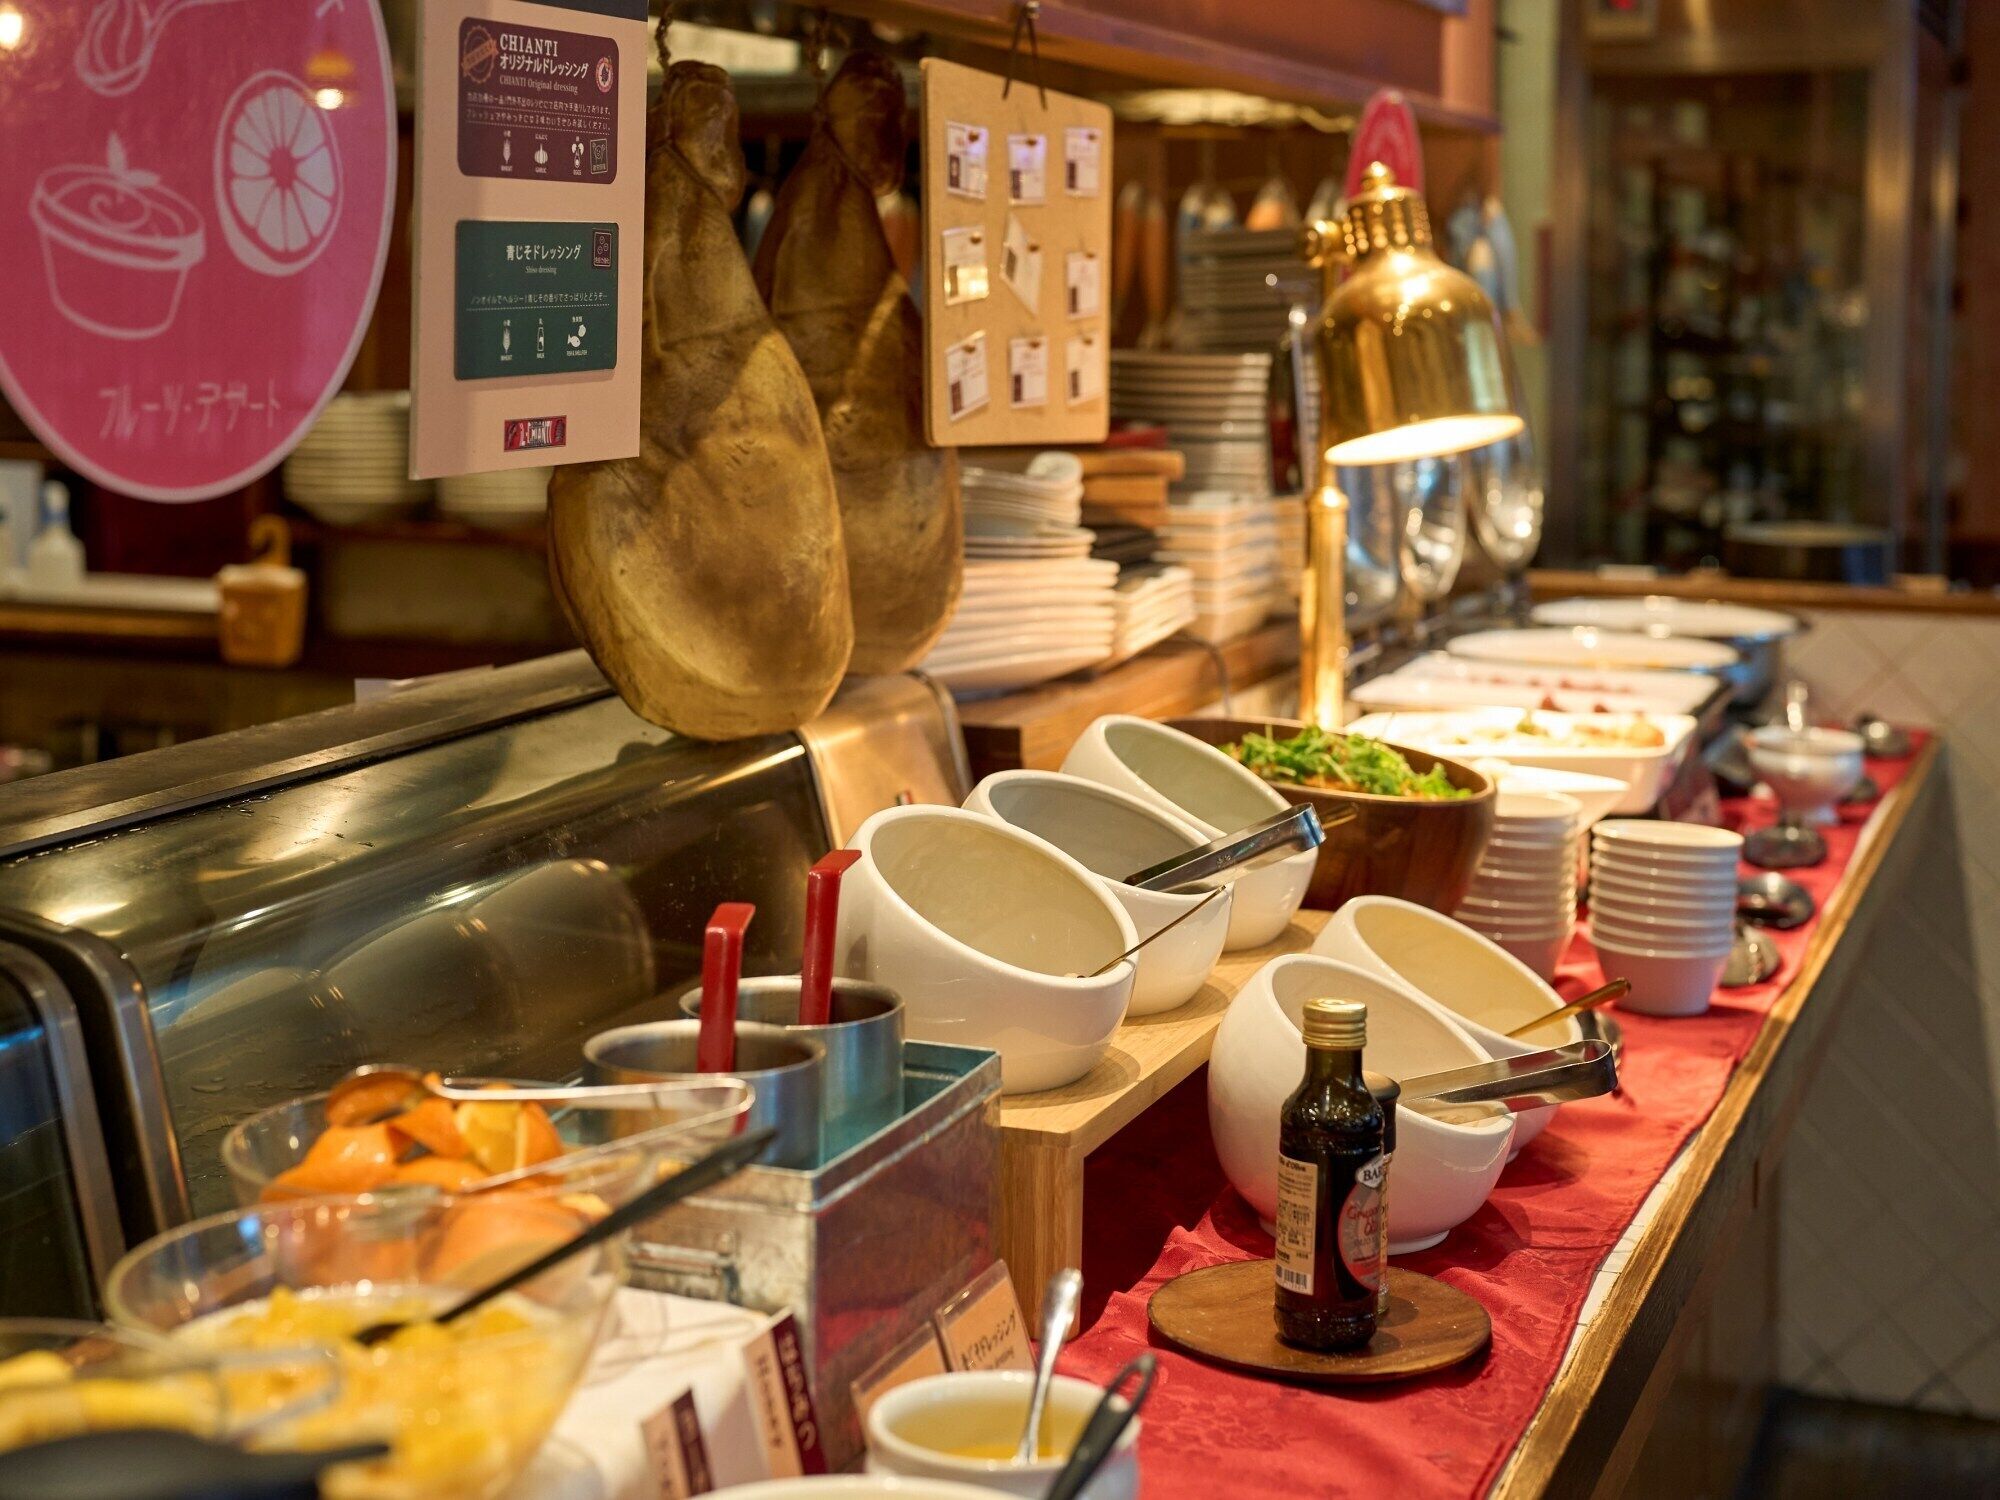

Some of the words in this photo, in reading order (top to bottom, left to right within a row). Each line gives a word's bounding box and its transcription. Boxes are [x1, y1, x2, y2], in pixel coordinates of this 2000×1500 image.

[500, 33, 558, 57] CHIANTI
[500, 53, 589, 79] オリジナルドレッシング
[500, 75, 527, 88] CHIANTI
[528, 78, 551, 90] Original
[553, 81, 579, 95] dressing
[506, 244, 582, 261] 青じそドレッシング
